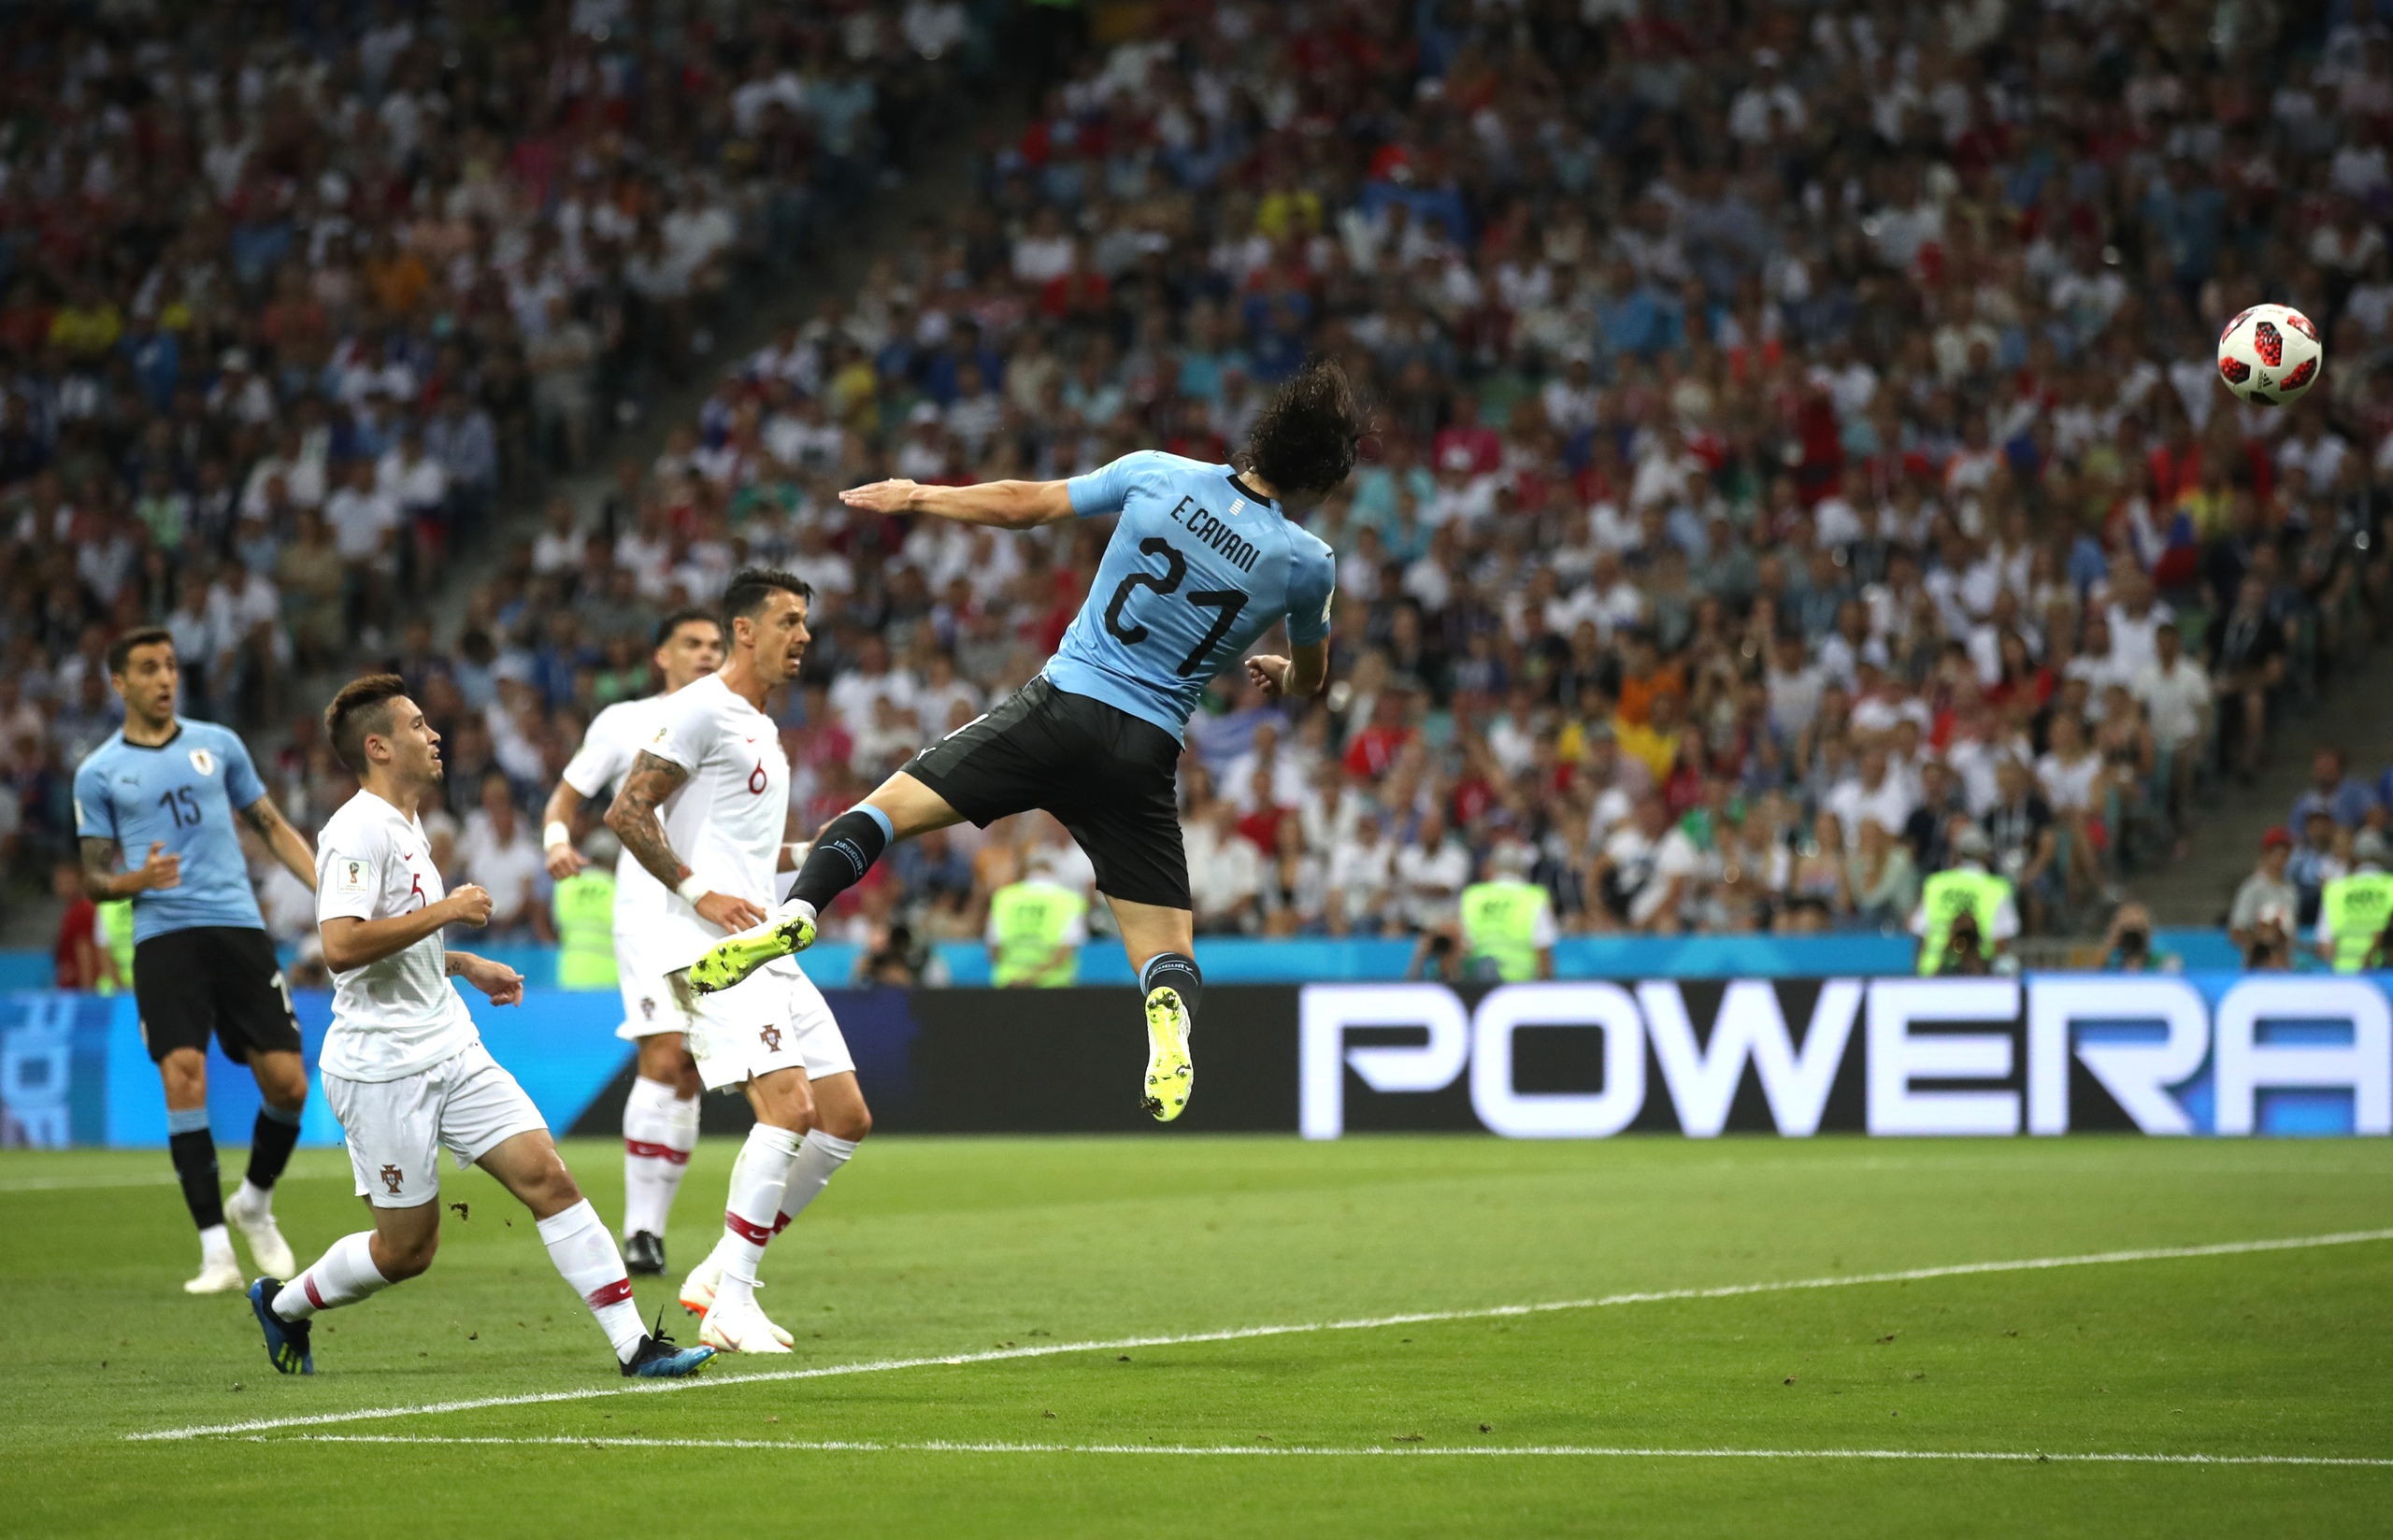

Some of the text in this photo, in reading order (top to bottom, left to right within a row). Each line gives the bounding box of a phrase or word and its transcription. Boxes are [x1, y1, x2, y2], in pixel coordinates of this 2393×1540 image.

[1104, 536, 1249, 678] 21
[748, 756, 767, 796] 6
[158, 785, 202, 830] 15
[406, 873, 426, 916] 5
[1298, 975, 2392, 1139] POWERA
